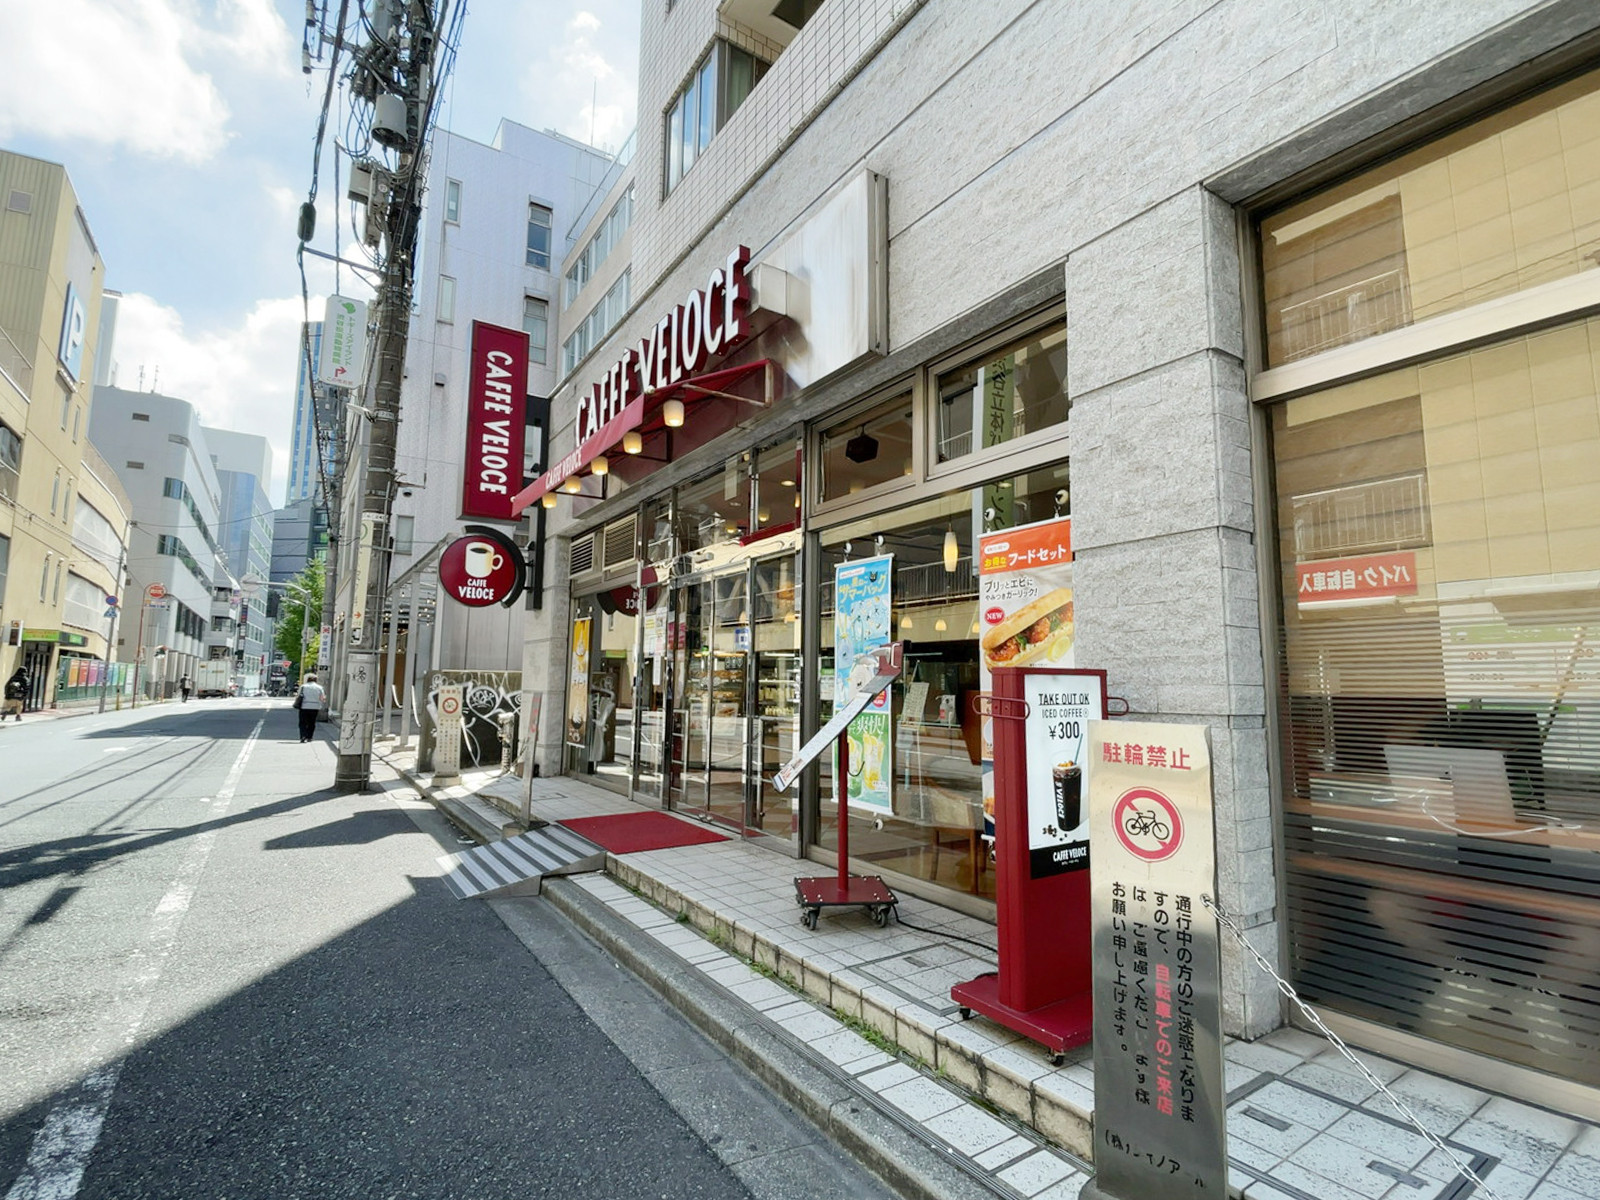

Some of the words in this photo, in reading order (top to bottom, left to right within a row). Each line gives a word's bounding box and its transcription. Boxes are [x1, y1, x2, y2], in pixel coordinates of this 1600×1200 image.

[637, 245, 746, 390] VELOCE
[65, 295, 85, 361] P
[479, 420, 511, 495] VELOCE
[1008, 544, 1067, 566] フードセット
[458, 585, 495, 600] VELOCE
[984, 577, 1033, 593] プリッとエビに
[986, 612, 1003, 620] NEW
[1038, 693, 1059, 705] TAKE
[1061, 693, 1077, 705] OUT
[1079, 692, 1090, 705] OK
[1042, 708, 1057, 718] ICED
[1059, 707, 1083, 718] COFFEE
[1048, 721, 1080, 740] ¥300
[1102, 742, 1192, 771] 駐輪禁止
[1068, 846, 1087, 859] VELOCE
[1112, 881, 1128, 1052] お願い申し上げます。
[1154, 891, 1173, 1116] すので、自転車でのご来店
